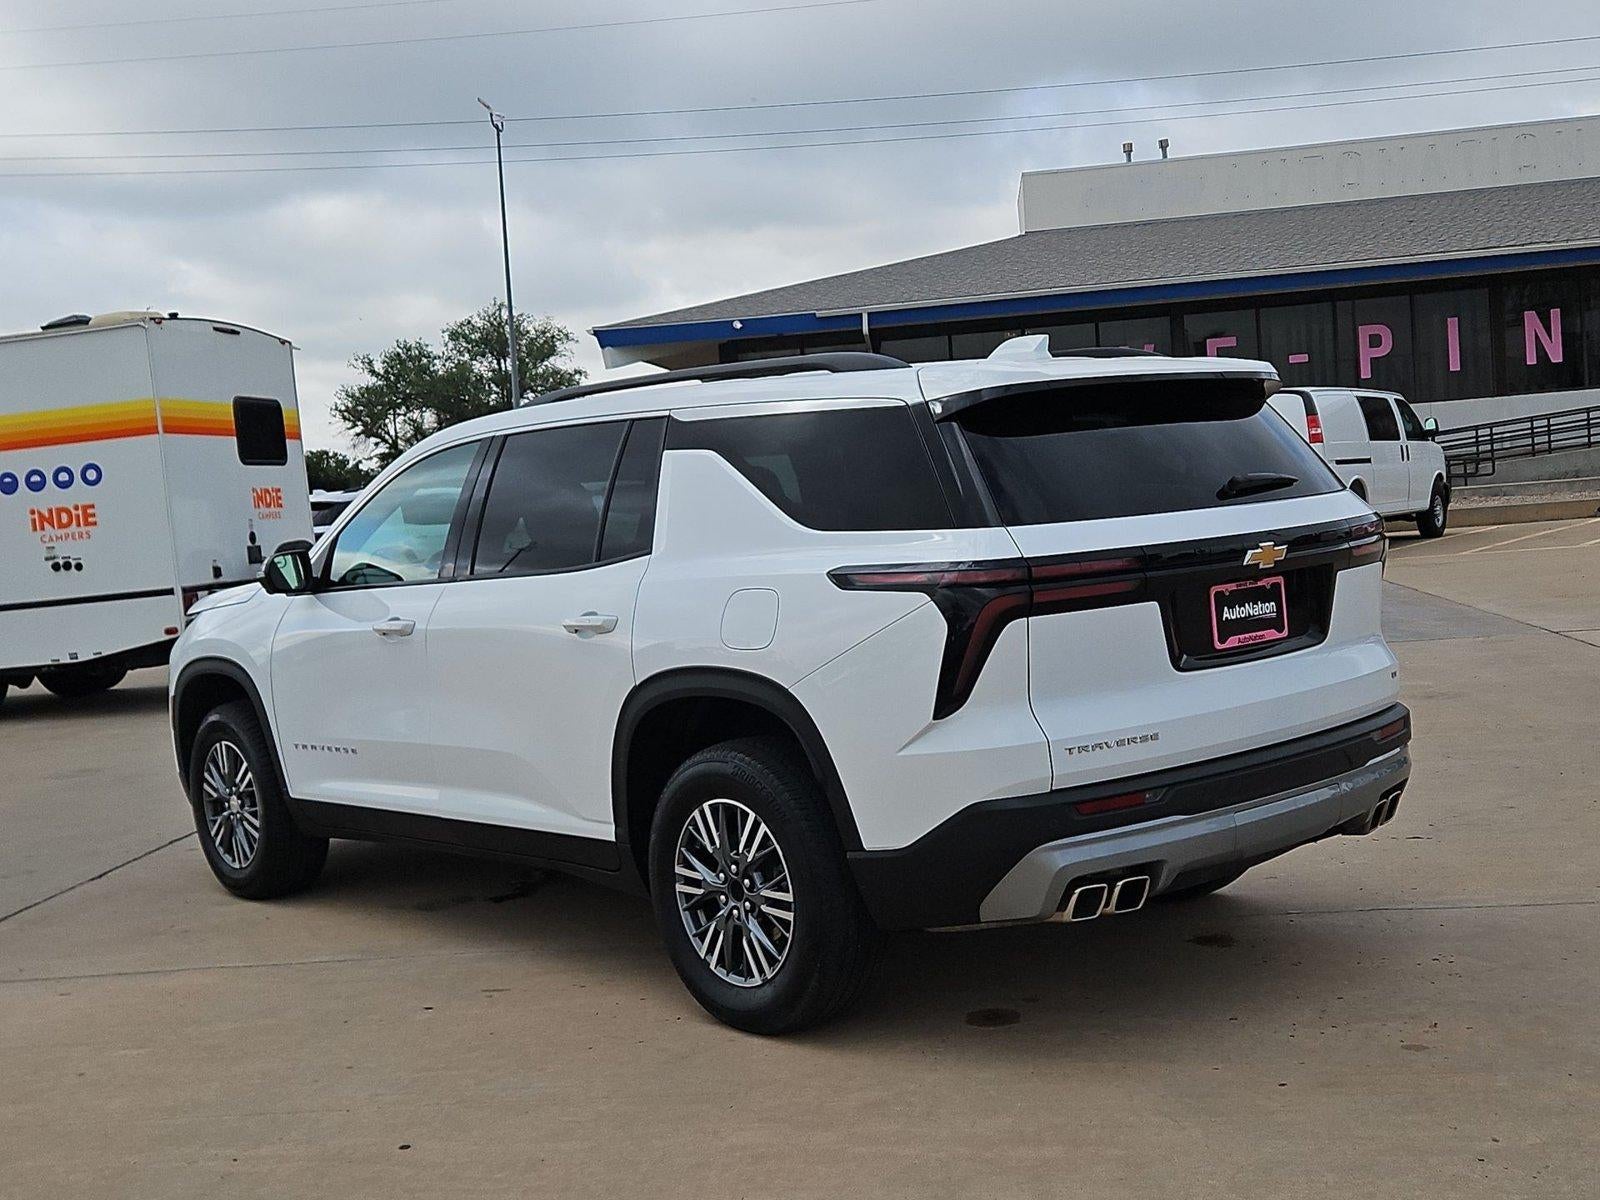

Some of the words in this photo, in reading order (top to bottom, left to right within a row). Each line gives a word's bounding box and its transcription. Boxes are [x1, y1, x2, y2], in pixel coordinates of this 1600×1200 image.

[40, 531, 91, 544] CAMPERS
[1222, 601, 1277, 621] AutoNation
[293, 743, 358, 754] TRAVERSE
[1064, 732, 1160, 755] TRAVERSE
